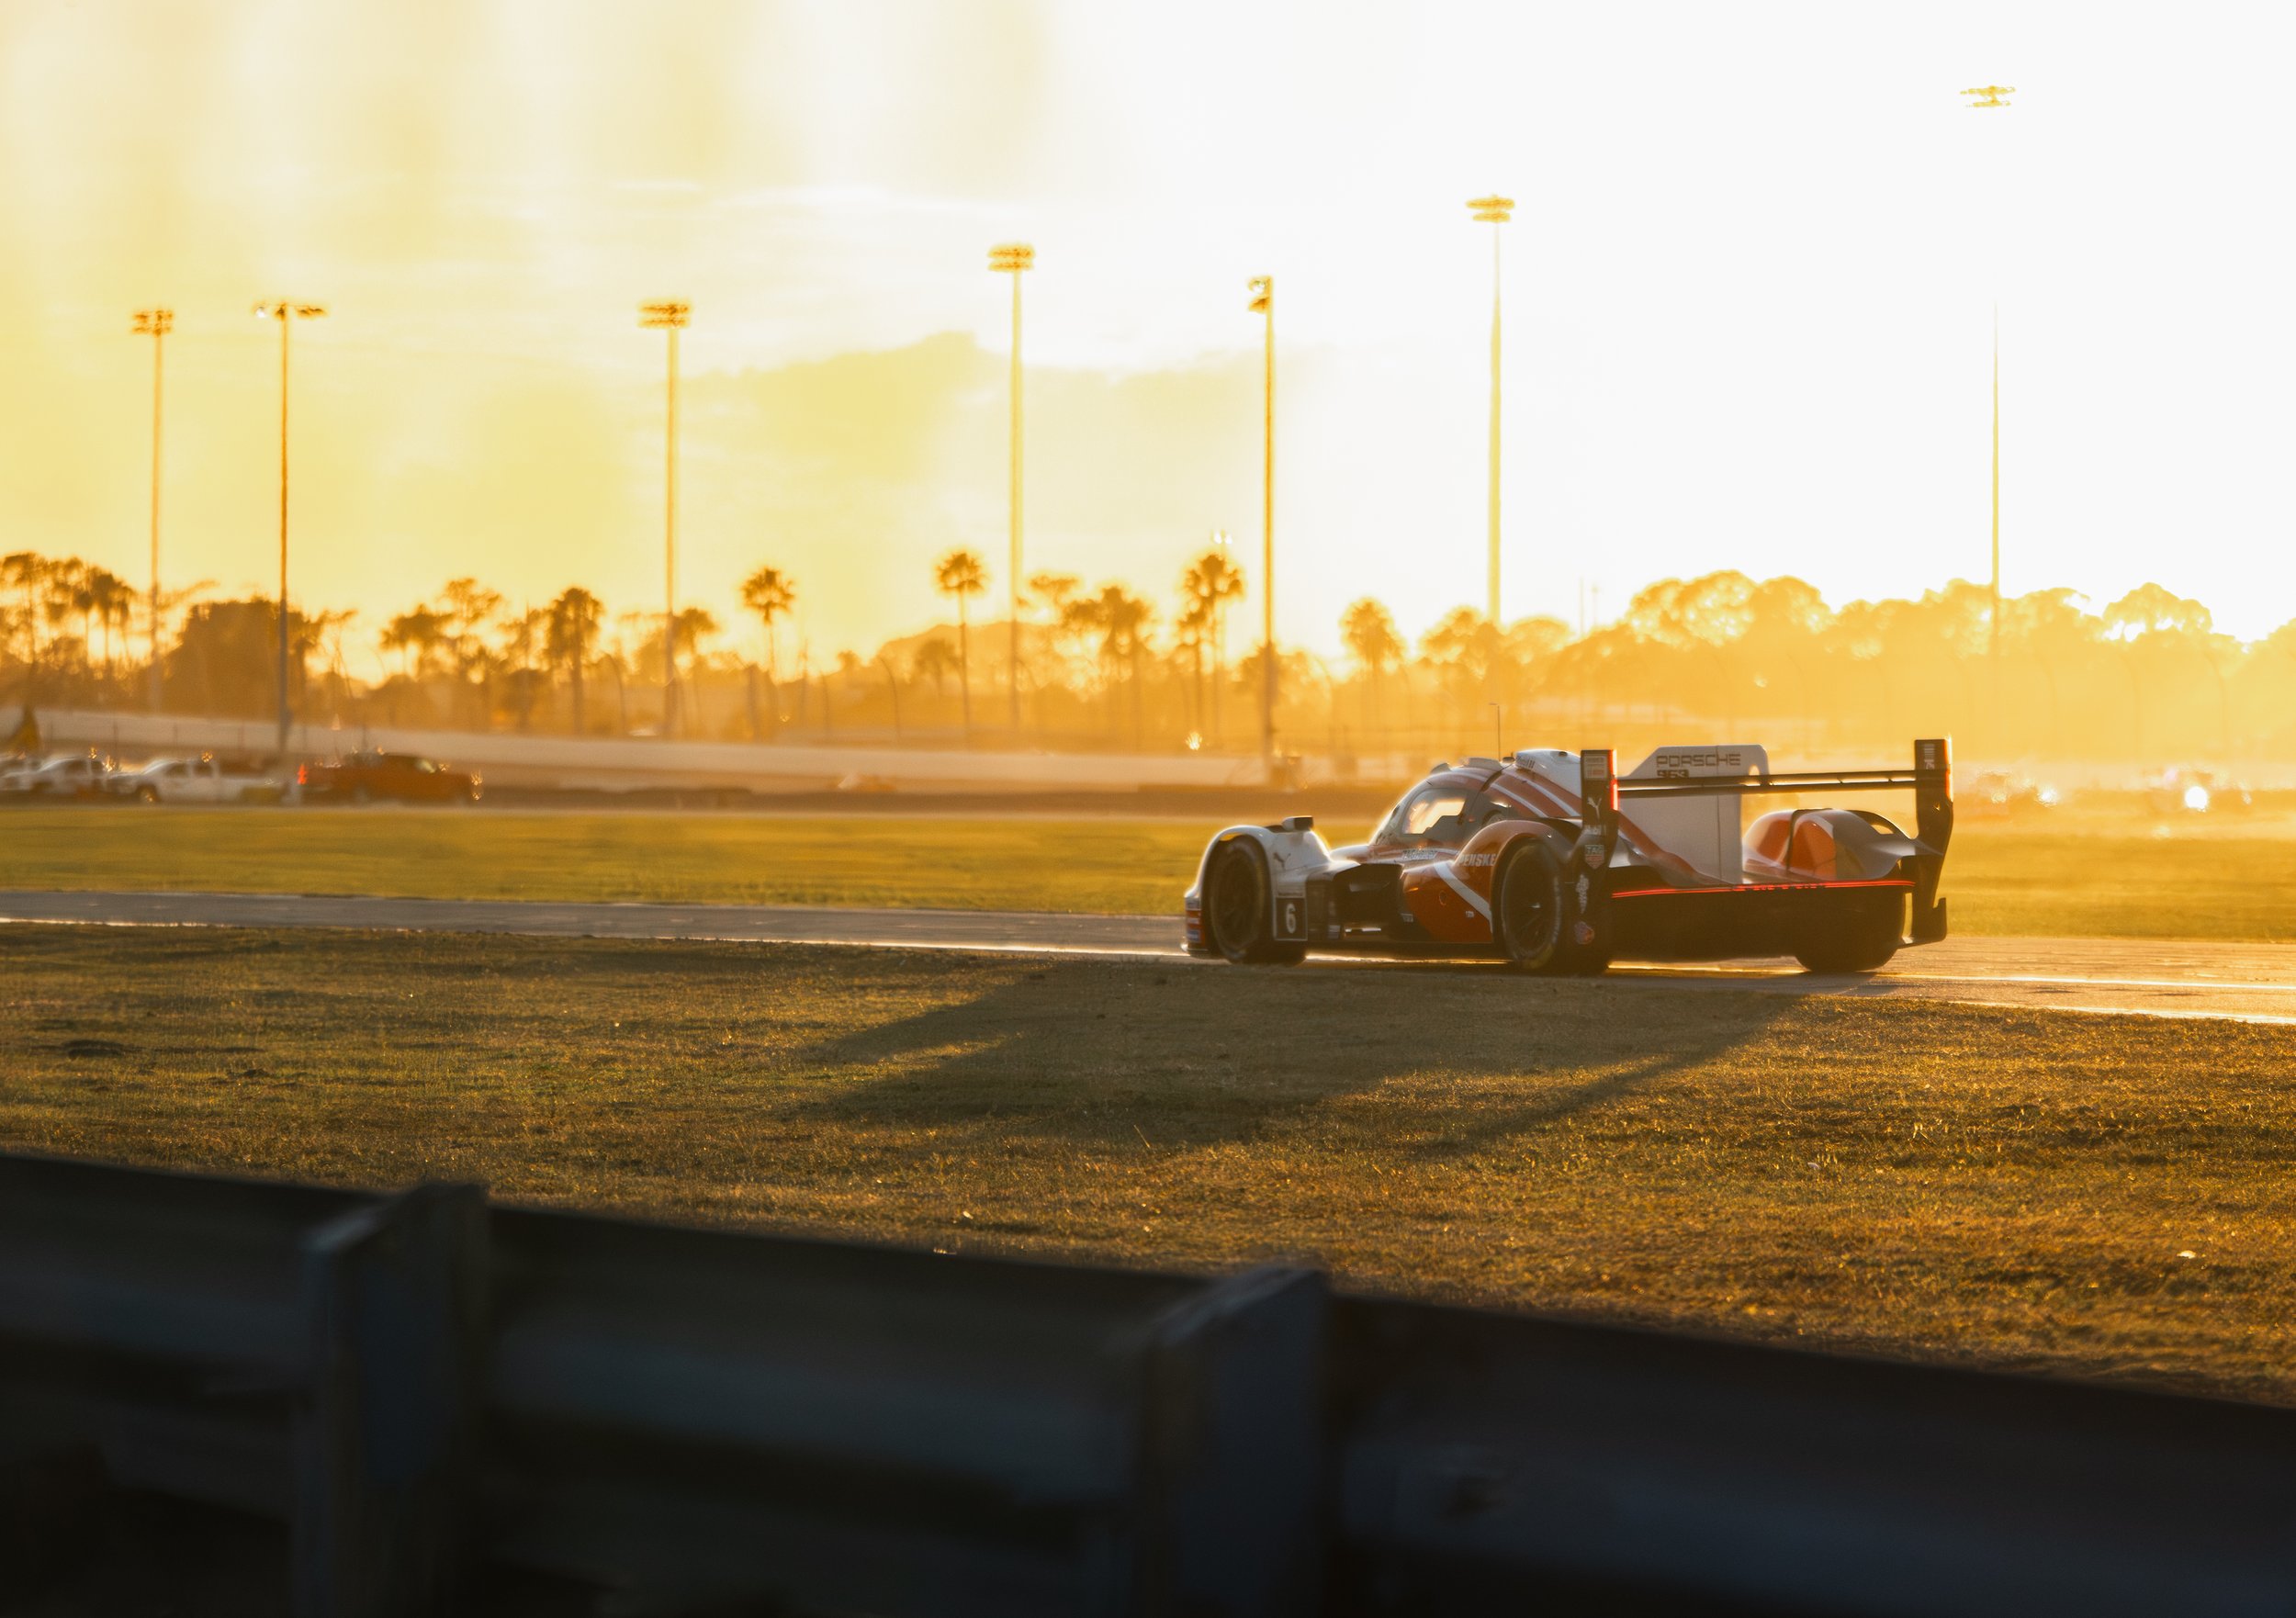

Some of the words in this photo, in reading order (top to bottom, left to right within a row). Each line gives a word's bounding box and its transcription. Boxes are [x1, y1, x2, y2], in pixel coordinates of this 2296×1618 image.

[1656, 753, 1741, 768] PORSCHE
[1457, 853, 1497, 867] PENSKE
[1285, 902, 1298, 935] 6
